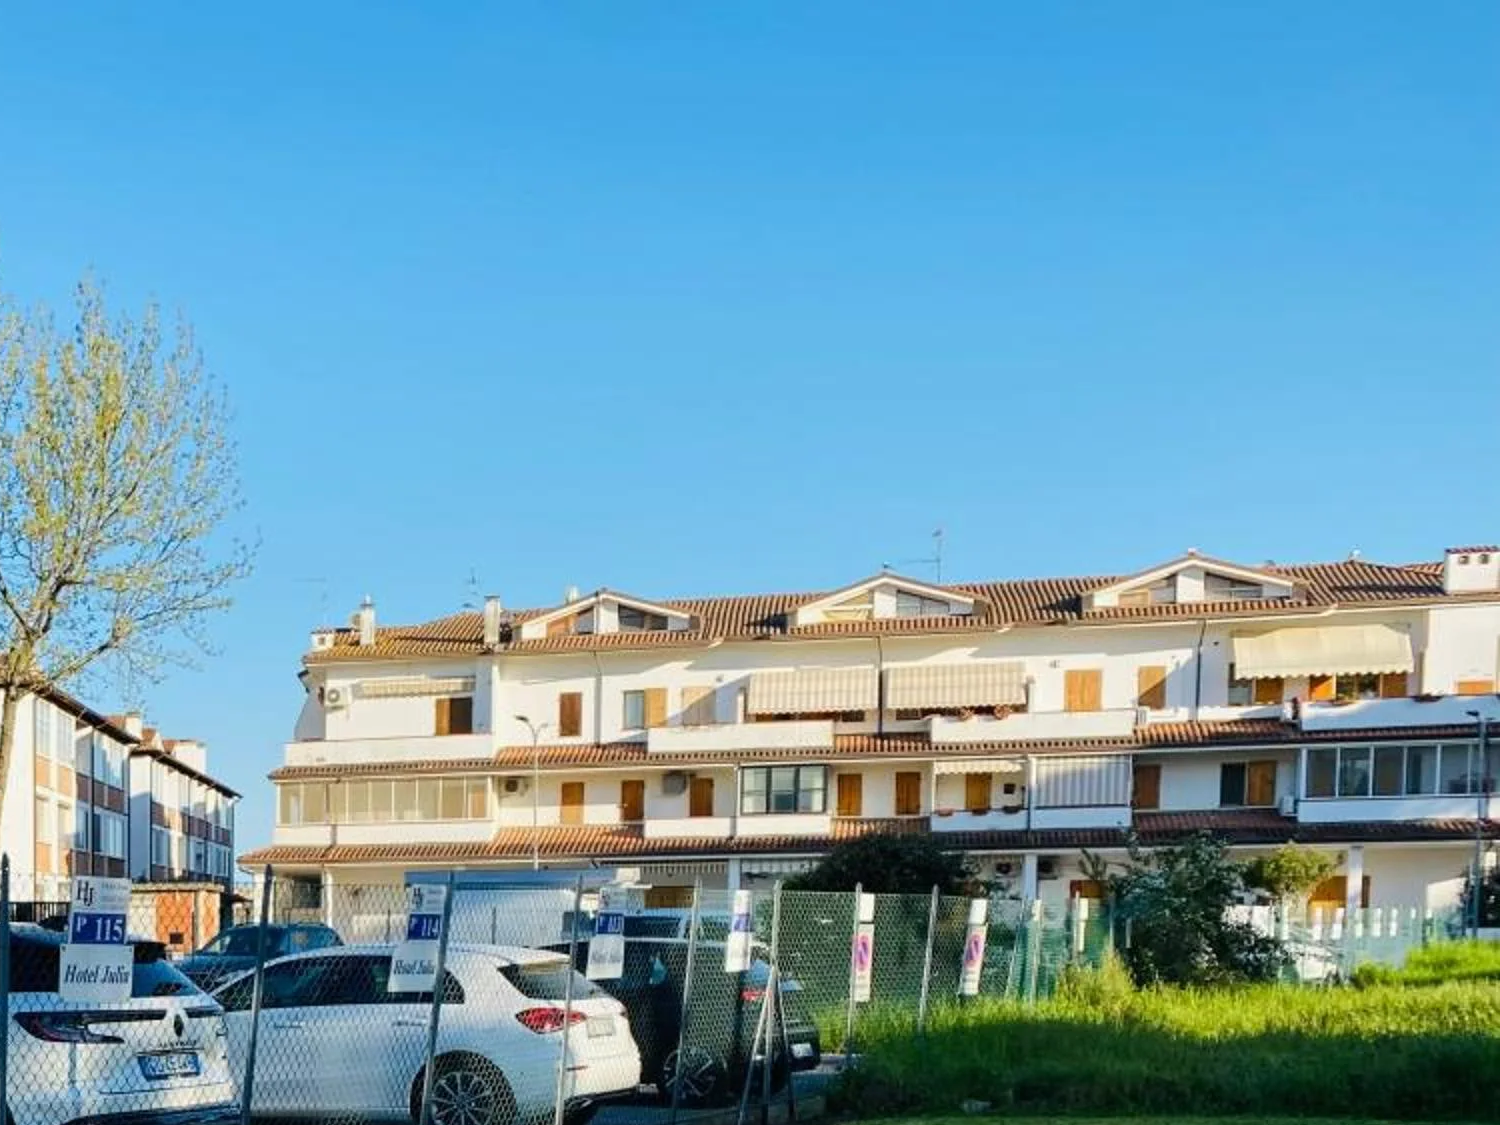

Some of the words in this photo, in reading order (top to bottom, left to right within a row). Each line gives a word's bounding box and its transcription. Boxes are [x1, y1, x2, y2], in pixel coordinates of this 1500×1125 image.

[76, 916, 88, 933] P
[95, 917, 123, 942] 115
[64, 964, 98, 984] Hotel
[101, 964, 130, 985] Julia
